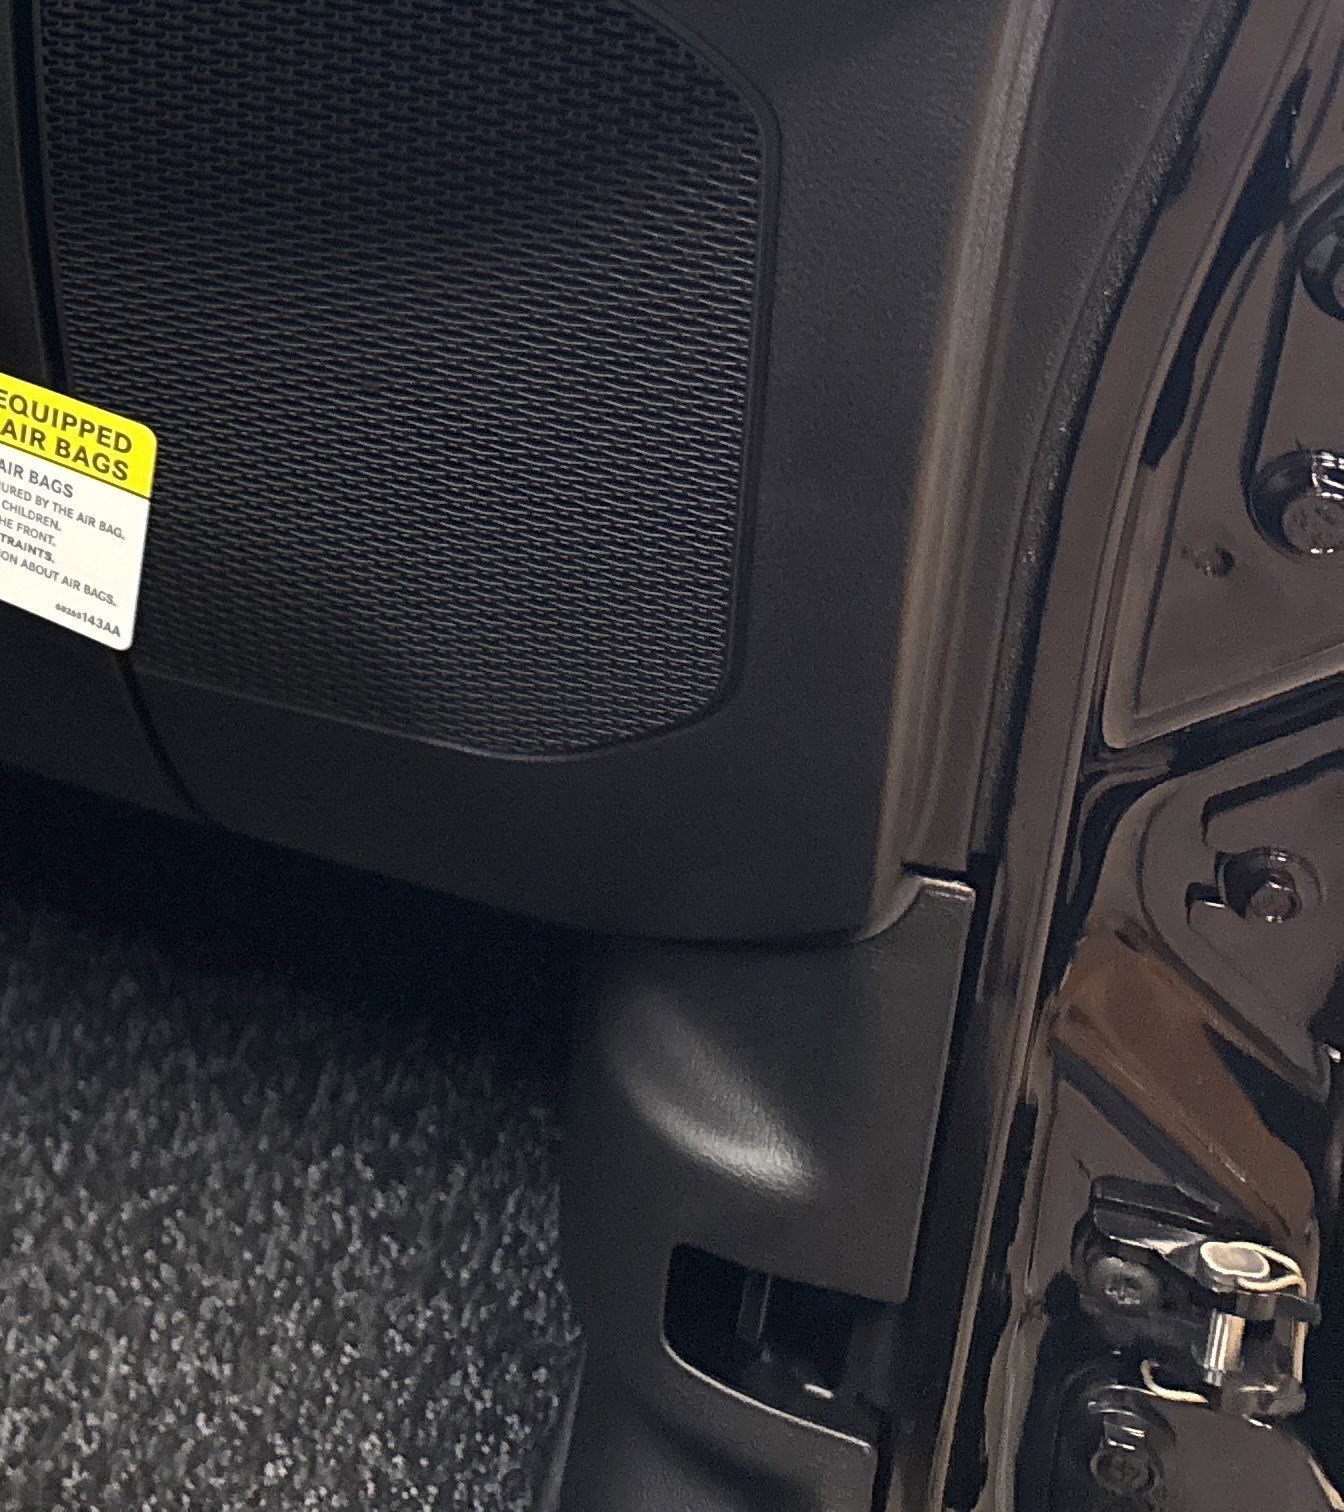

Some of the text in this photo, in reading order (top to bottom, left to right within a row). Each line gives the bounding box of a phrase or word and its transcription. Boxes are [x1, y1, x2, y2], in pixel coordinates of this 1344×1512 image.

[0, 418, 47, 452] AIR
[54, 436, 129, 481] BAGS
[28, 469, 73, 498] BAGS
[1, 499, 62, 531] CHILDREN.
[16, 522, 56, 547] FRONT.
[35, 494, 50, 509] BY
[52, 501, 74, 519] THE
[76, 512, 96, 528] AIR
[98, 520, 125, 540] BAG.
[20, 559, 60, 582] ABOUT
[61, 575, 81, 591] AIR
[83, 584, 117, 607] BAGS.
